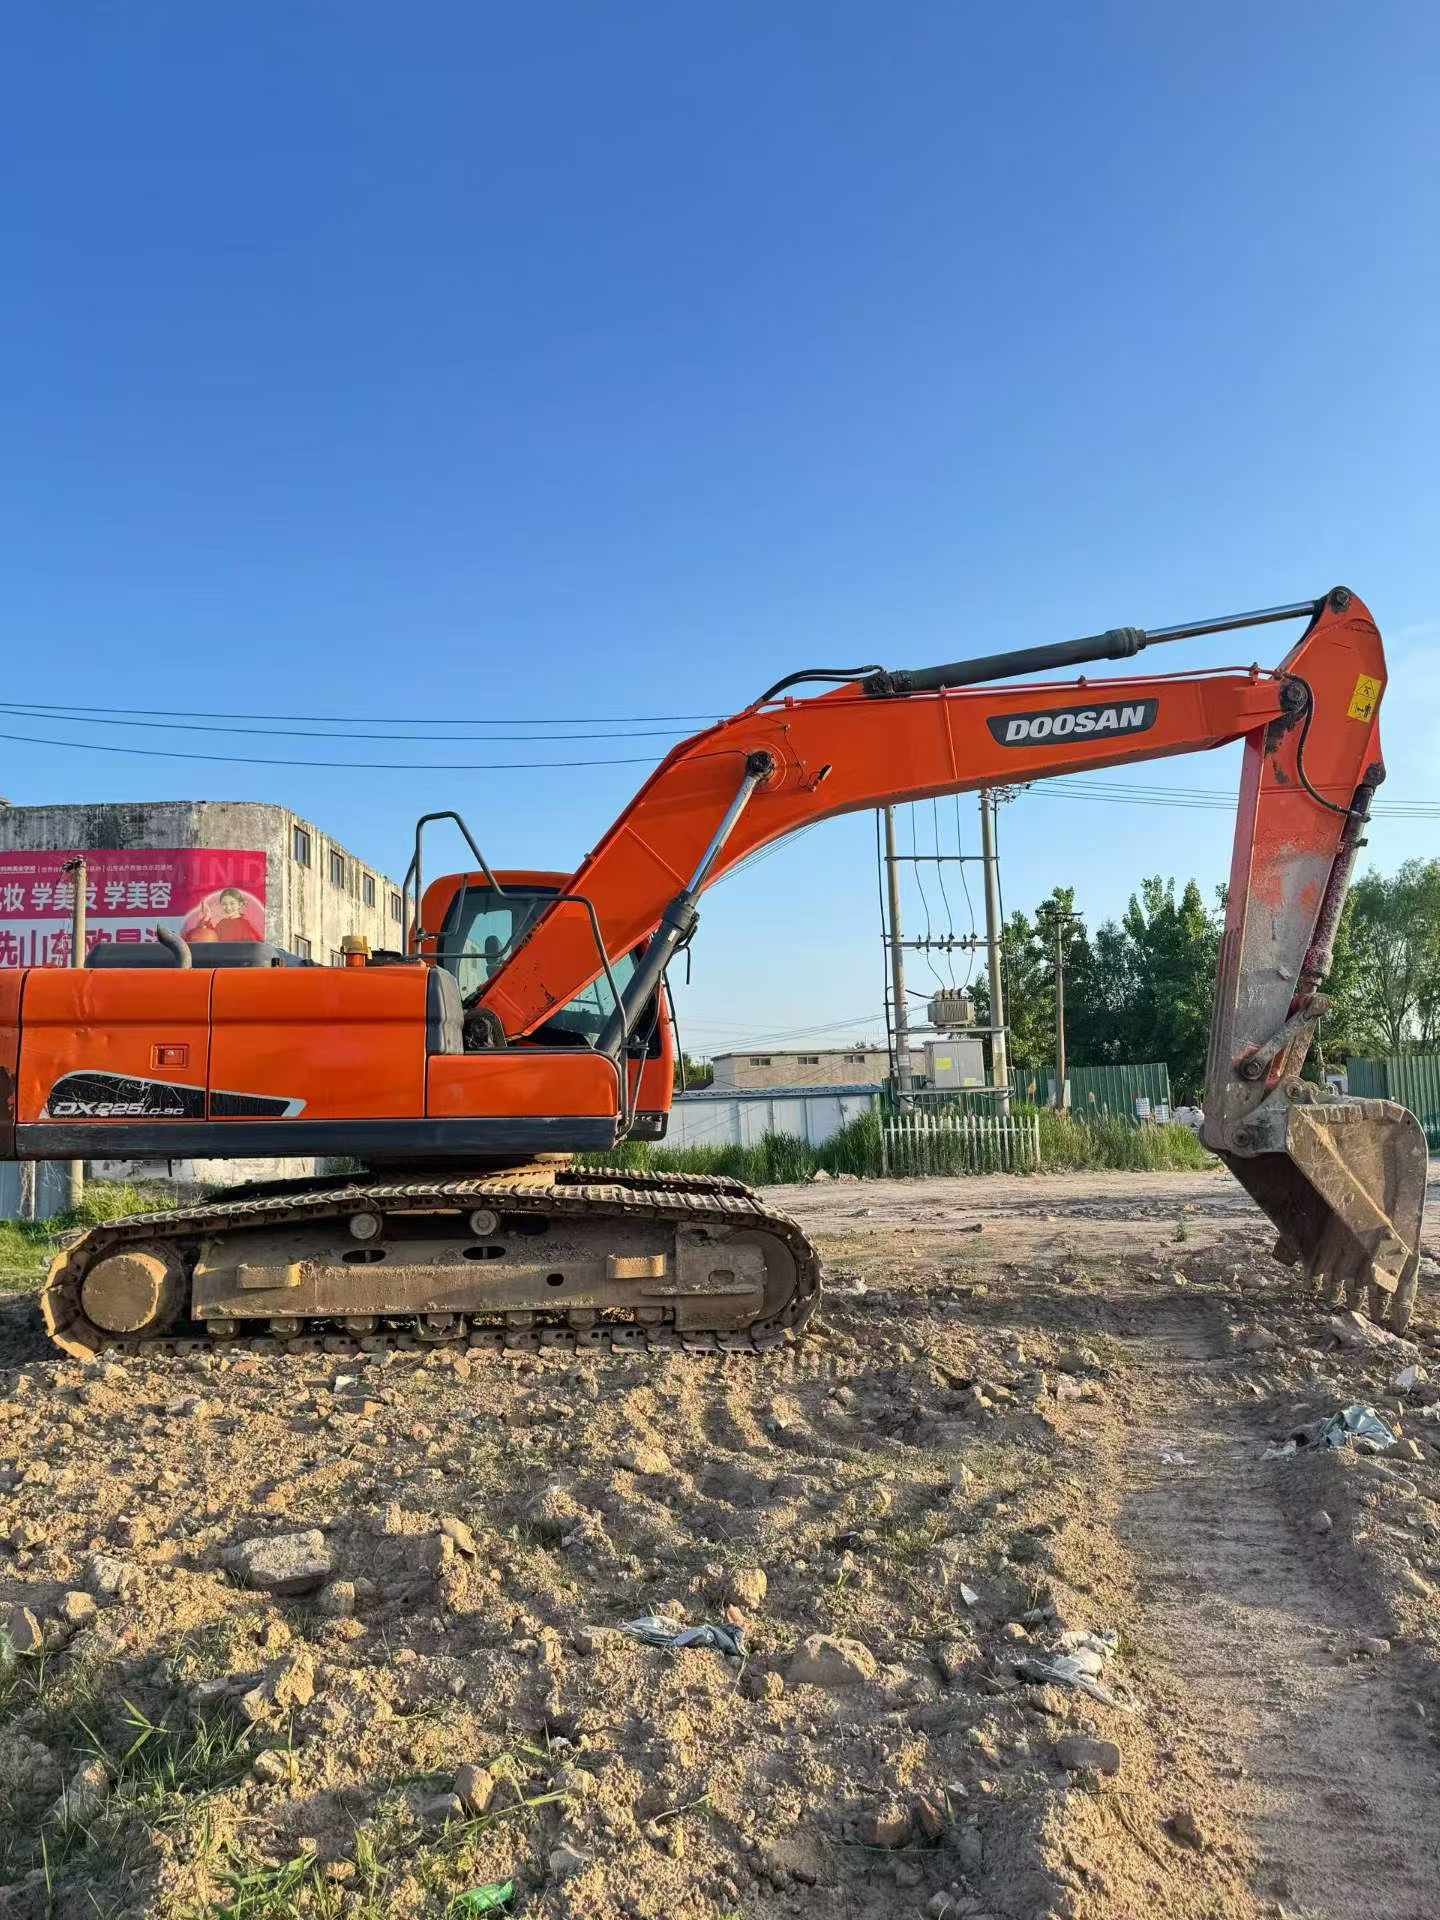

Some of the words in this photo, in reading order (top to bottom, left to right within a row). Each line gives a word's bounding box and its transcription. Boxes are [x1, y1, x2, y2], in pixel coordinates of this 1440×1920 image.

[1005, 705, 1145, 742] DOOSAN
[0, 883, 25, 912] 妆
[104, 880, 171, 910] 学美容
